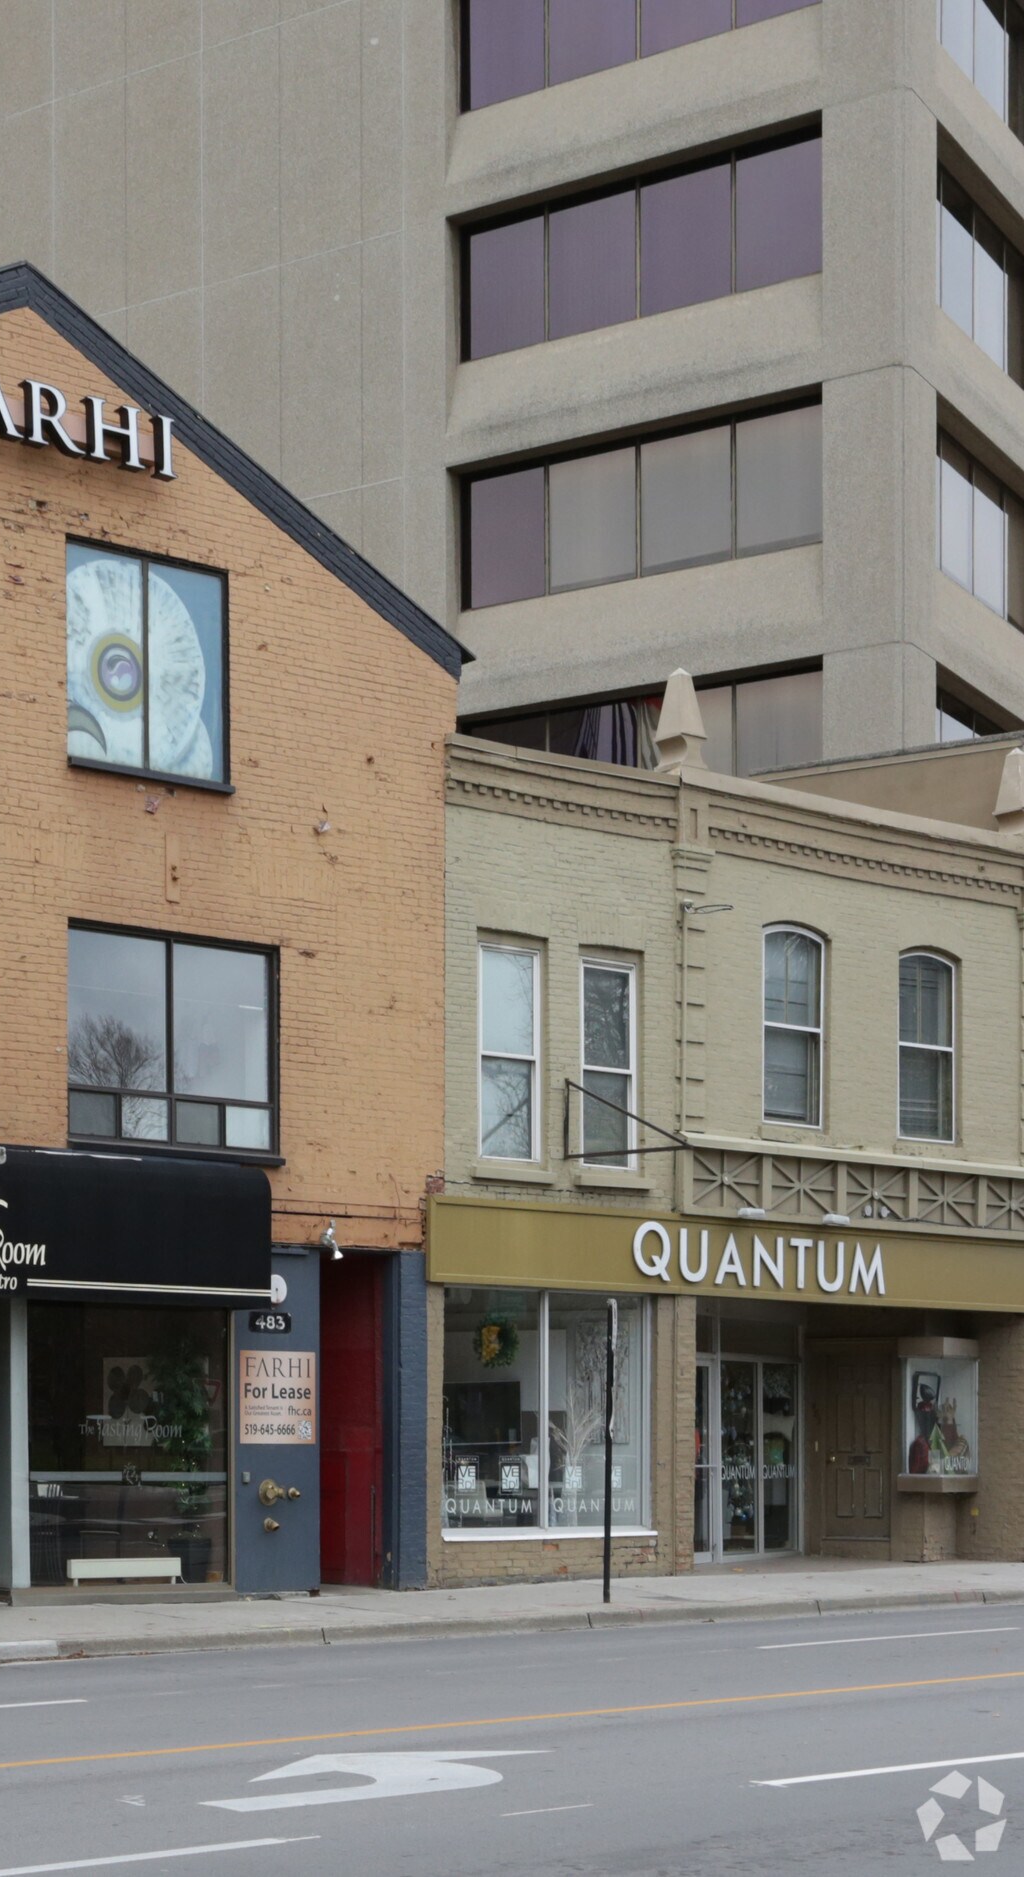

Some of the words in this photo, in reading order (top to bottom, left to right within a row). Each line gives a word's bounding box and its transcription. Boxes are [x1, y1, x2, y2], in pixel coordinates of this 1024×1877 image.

[633, 1221, 885, 1295] QUANTUM
[255, 1315, 285, 1330] 483
[245, 1356, 311, 1378] FARHI
[244, 1383, 267, 1399] For
[271, 1383, 311, 1400] Lease
[288, 1405, 312, 1416] fhc.ca
[140, 1415, 182, 1442] Room
[244, 1423, 296, 1435] 519-645-6666
[944, 1455, 971, 1471] QUANTUM
[721, 1465, 756, 1481] QUANTUM
[762, 1464, 796, 1480] QUANTUM
[444, 1497, 533, 1514] QUANTUM
[554, 1497, 635, 1513] QUANUM
